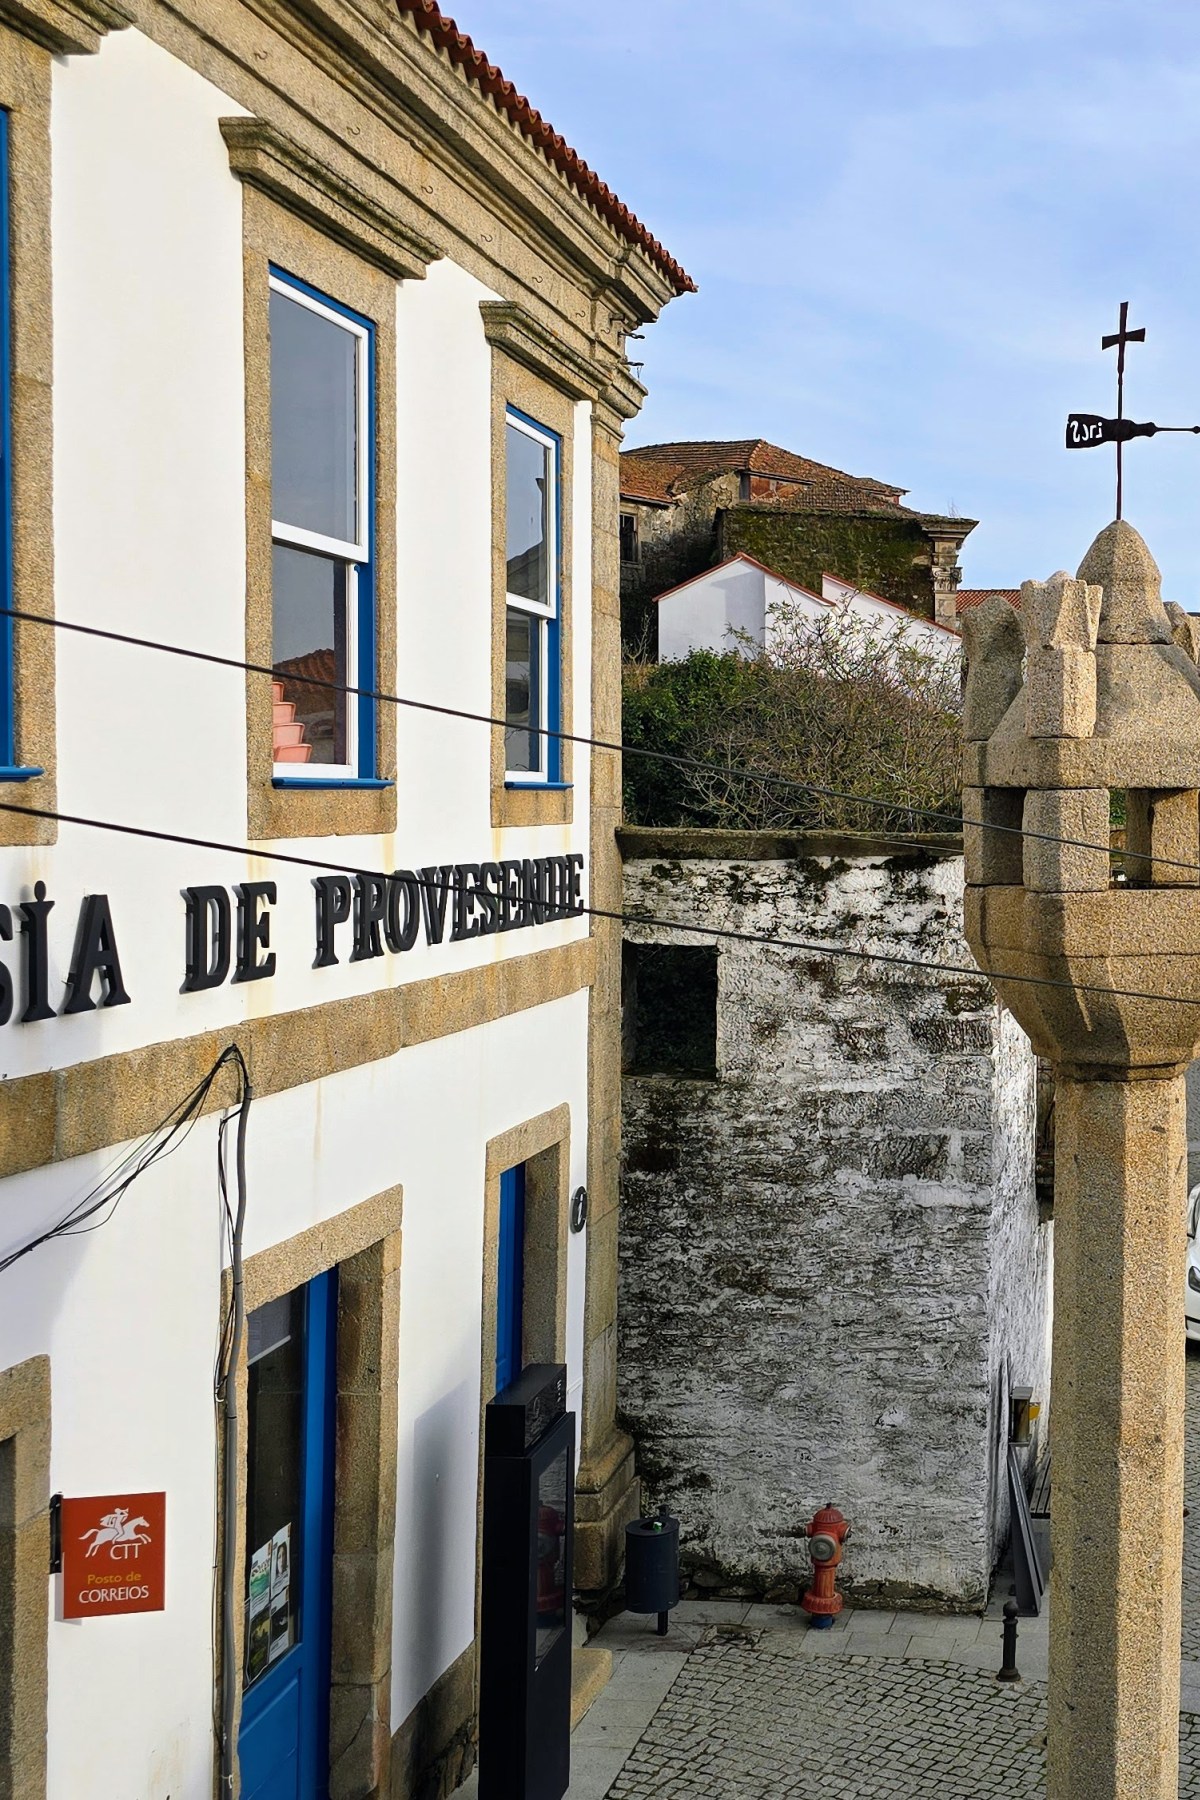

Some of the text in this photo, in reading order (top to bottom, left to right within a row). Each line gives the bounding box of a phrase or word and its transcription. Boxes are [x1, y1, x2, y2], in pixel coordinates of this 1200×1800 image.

[183, 880, 277, 992] DE
[316, 853, 584, 966] PROVESENDE
[110, 1542, 142, 1560] CTT
[87, 1571, 142, 1585] Posto de
[78, 1585, 149, 1603] CORREIOS
